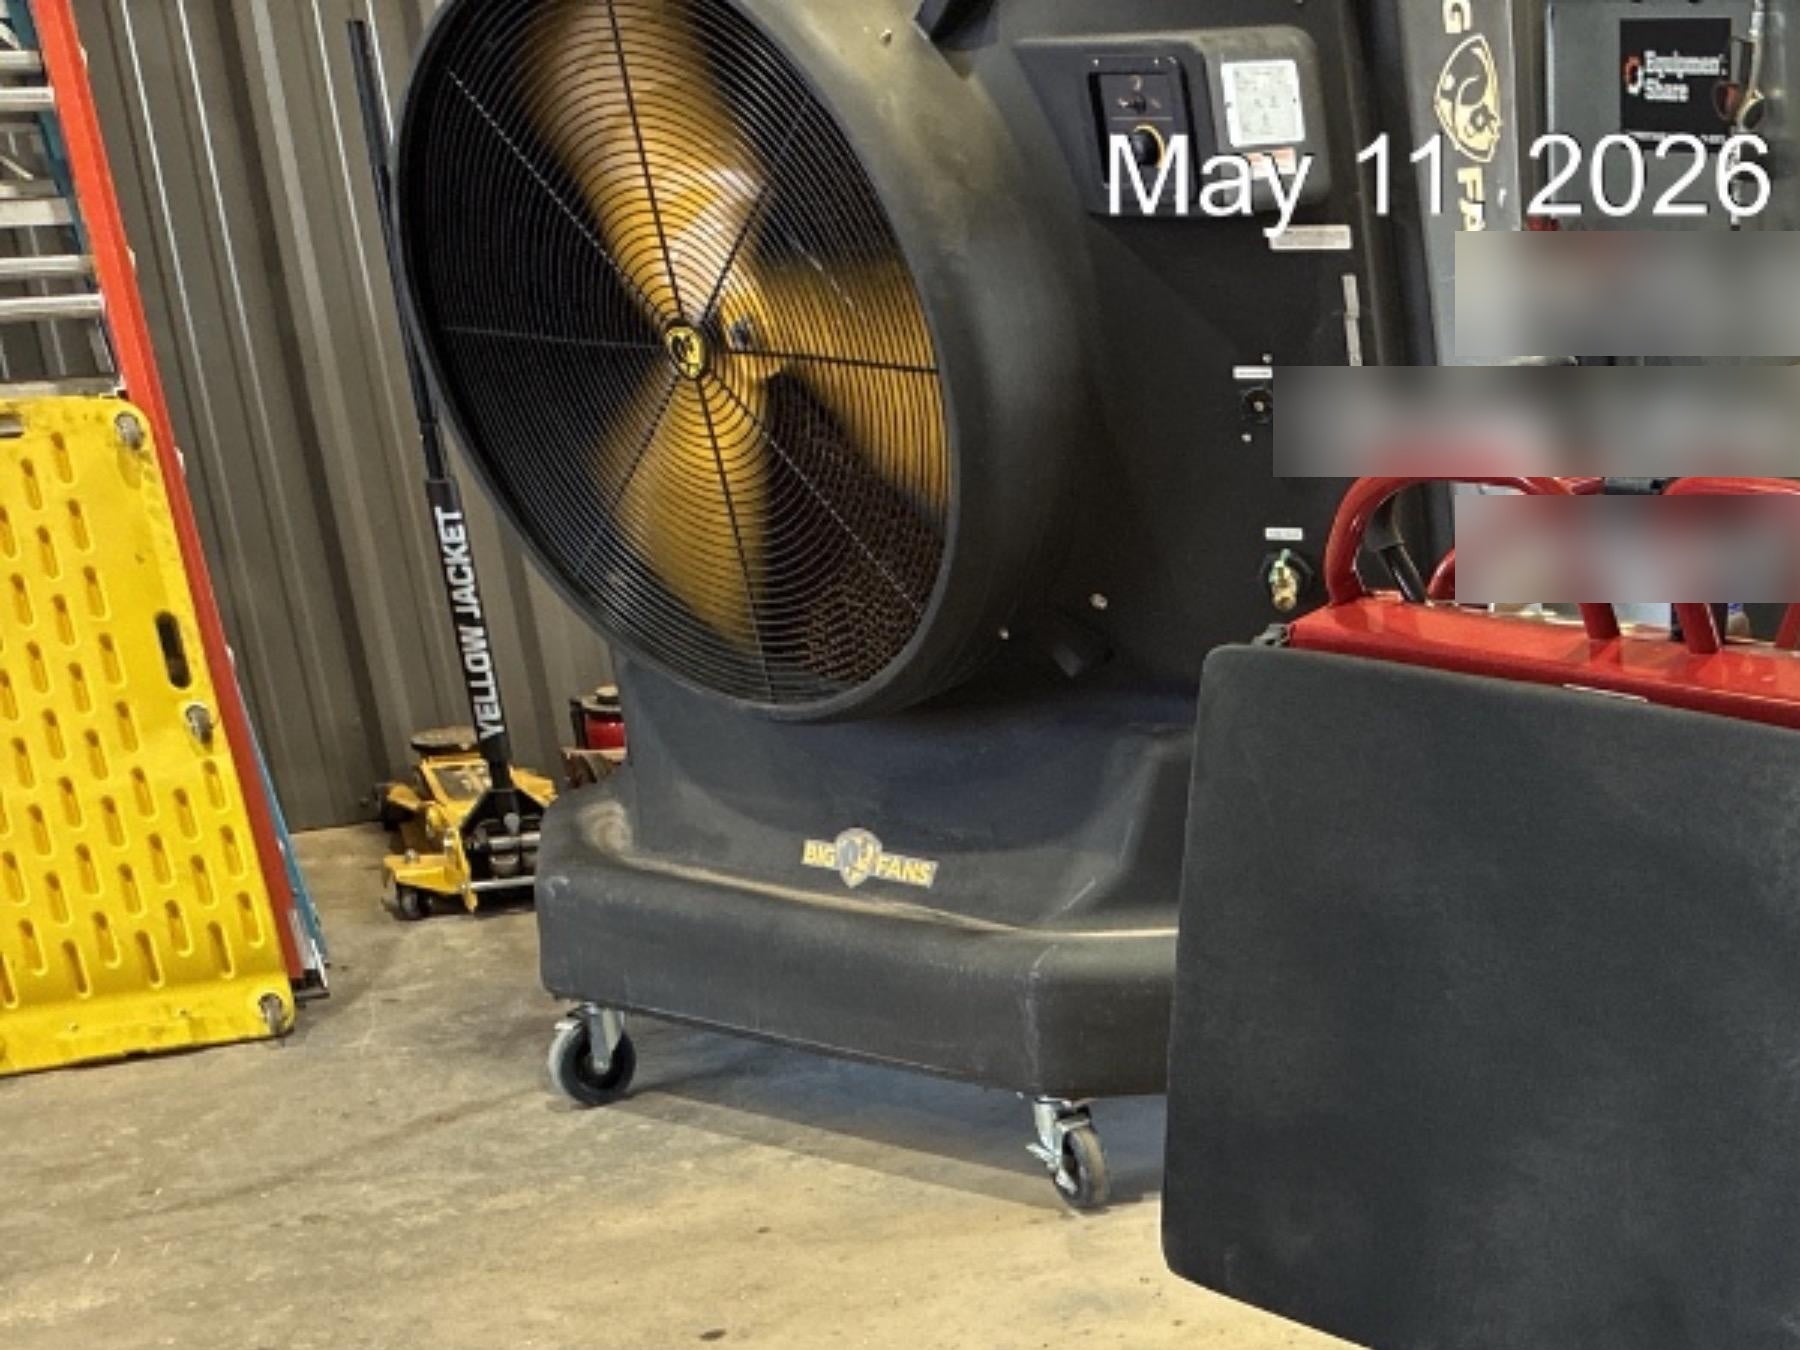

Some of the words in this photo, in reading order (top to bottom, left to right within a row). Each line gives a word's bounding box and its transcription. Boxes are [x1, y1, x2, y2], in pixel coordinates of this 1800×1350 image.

[434, 506, 482, 620] JACKET
[458, 624, 505, 740] YELLOW
[804, 841, 837, 867] BIG
[877, 855, 938, 886] FANS
